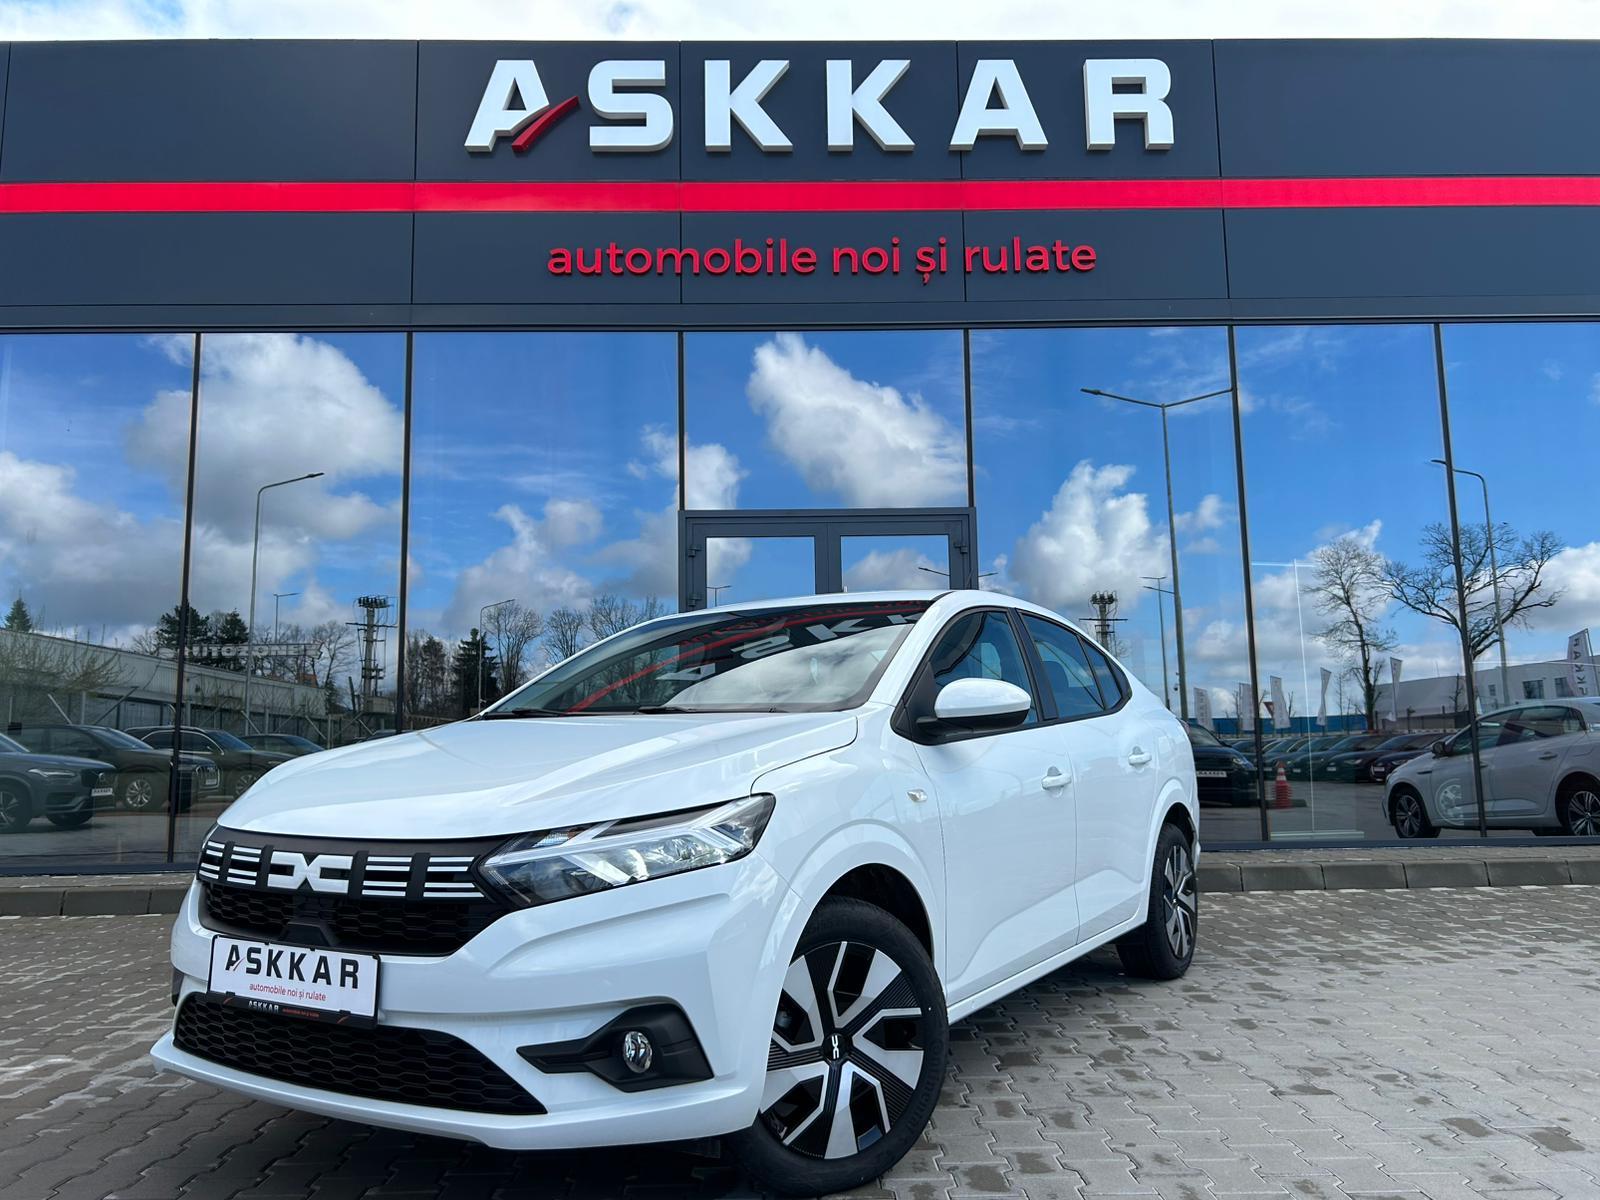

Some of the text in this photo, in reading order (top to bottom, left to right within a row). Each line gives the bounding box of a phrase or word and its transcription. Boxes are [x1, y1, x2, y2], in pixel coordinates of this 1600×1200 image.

[464, 58, 1175, 152] ASKKAR
[547, 236, 1097, 285] automobile noi și rulate
[225, 944, 359, 989] ASKKAR
[248, 1000, 279, 1013] ASKKAR
[249, 983, 286, 996] automobile
[286, 988, 298, 997] noi
[305, 991, 327, 1001] rulate
